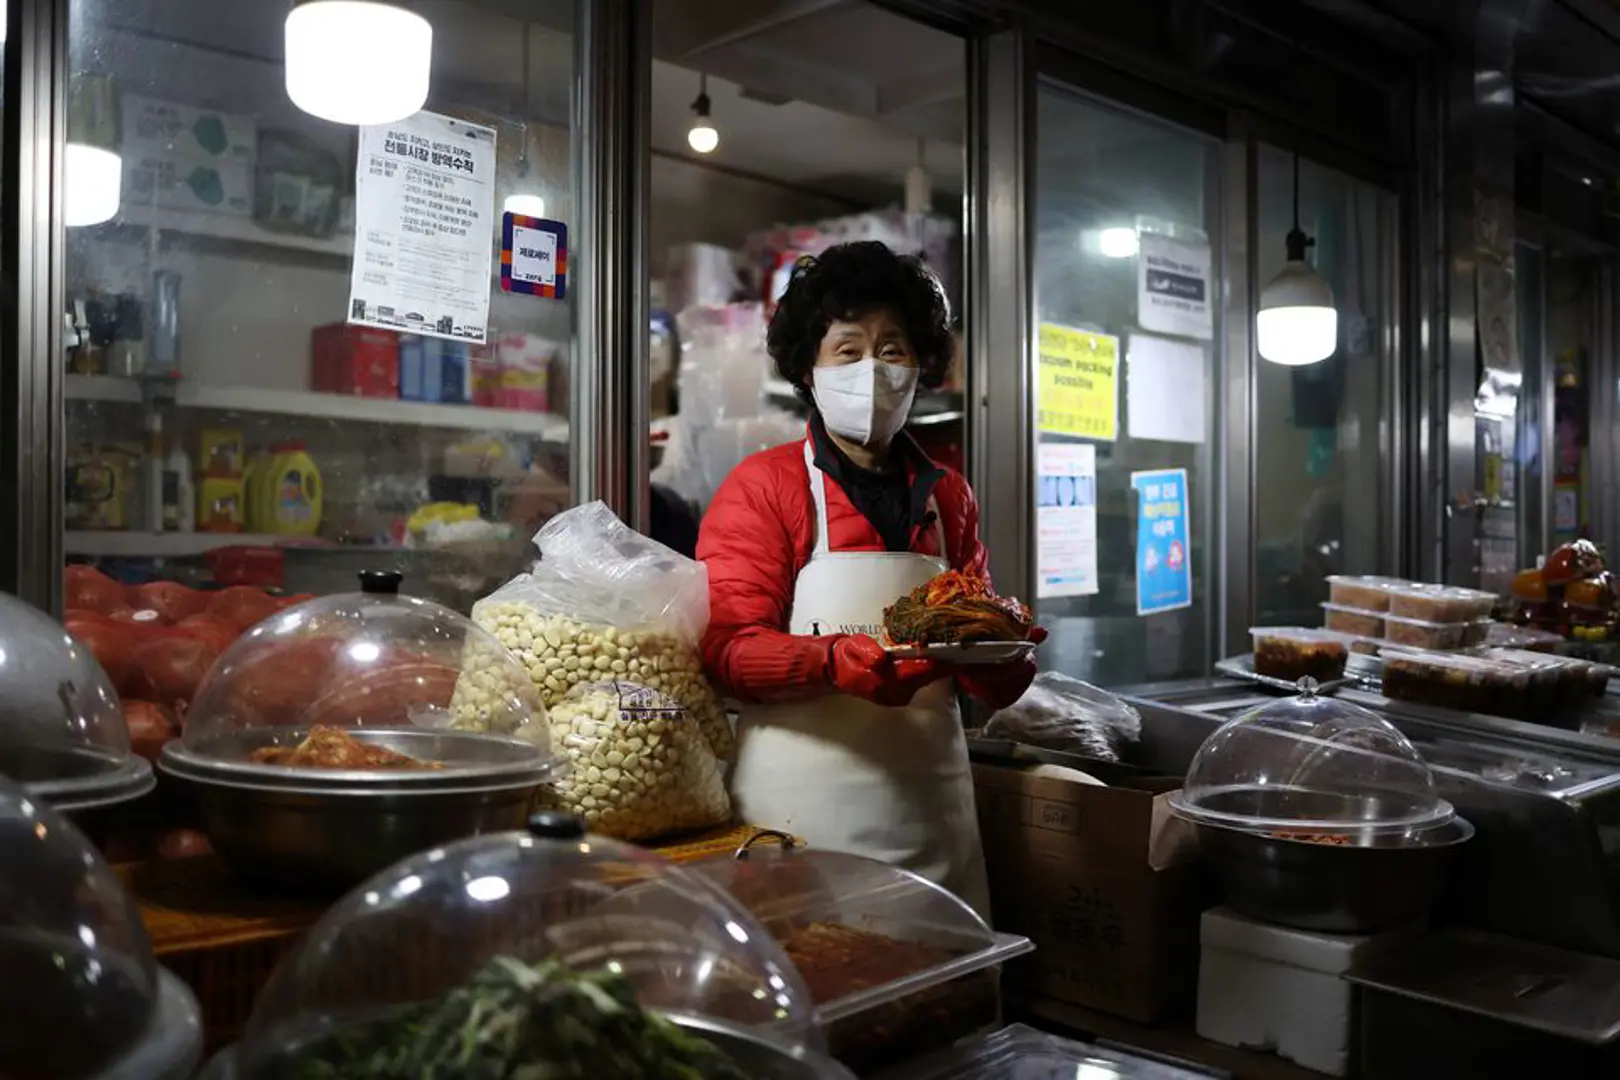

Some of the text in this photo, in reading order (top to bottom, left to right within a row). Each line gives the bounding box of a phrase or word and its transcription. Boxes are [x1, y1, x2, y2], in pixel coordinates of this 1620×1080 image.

[385, 140, 429, 163] 전통시장
[431, 151, 475, 174] 방역수칙
[519, 247, 550, 262] 제로페이
